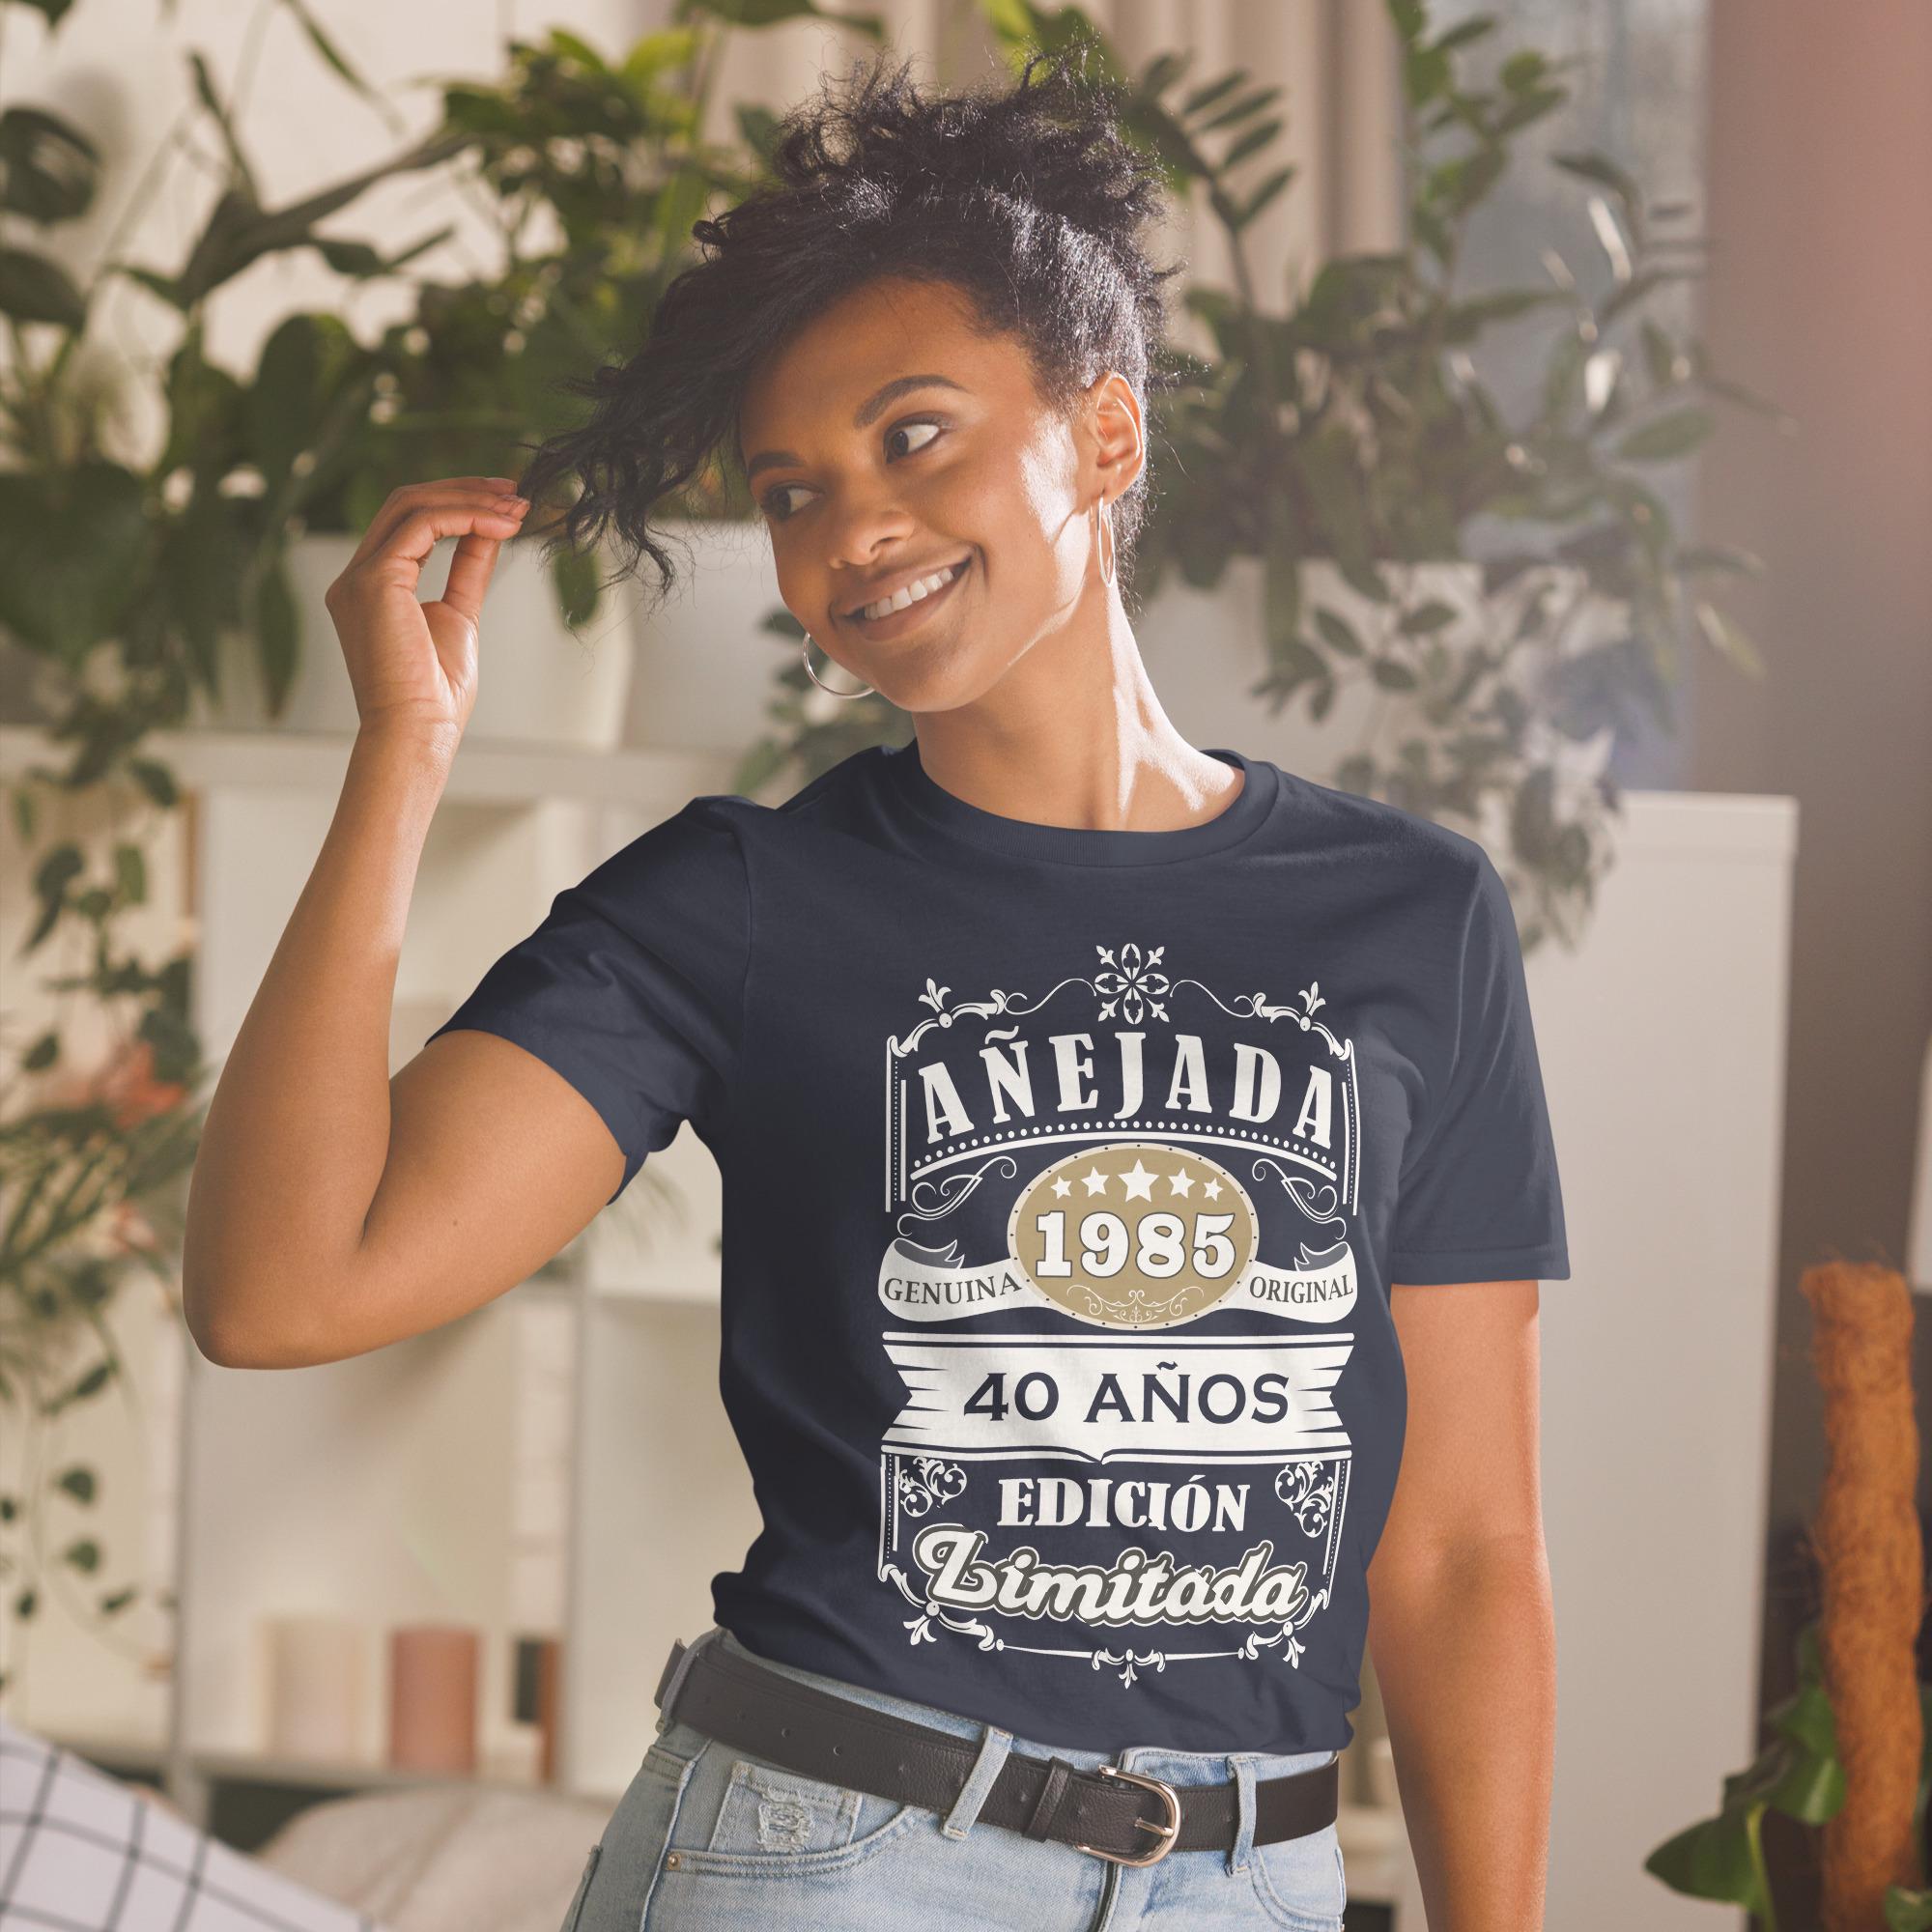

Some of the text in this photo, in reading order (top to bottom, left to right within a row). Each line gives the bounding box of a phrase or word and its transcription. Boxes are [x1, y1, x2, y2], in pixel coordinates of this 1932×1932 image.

[918, 1025, 1332, 1150] AÑEJADA
[1035, 1209, 1237, 1280] 1985
[883, 1271, 1022, 1306] GENUINA
[1249, 1273, 1353, 1305] ORIGINAL
[963, 1360, 1290, 1425] 40 AÑOS
[997, 1474, 1251, 1533] EDICIÓN
[912, 1521, 1308, 1627] Limitada
